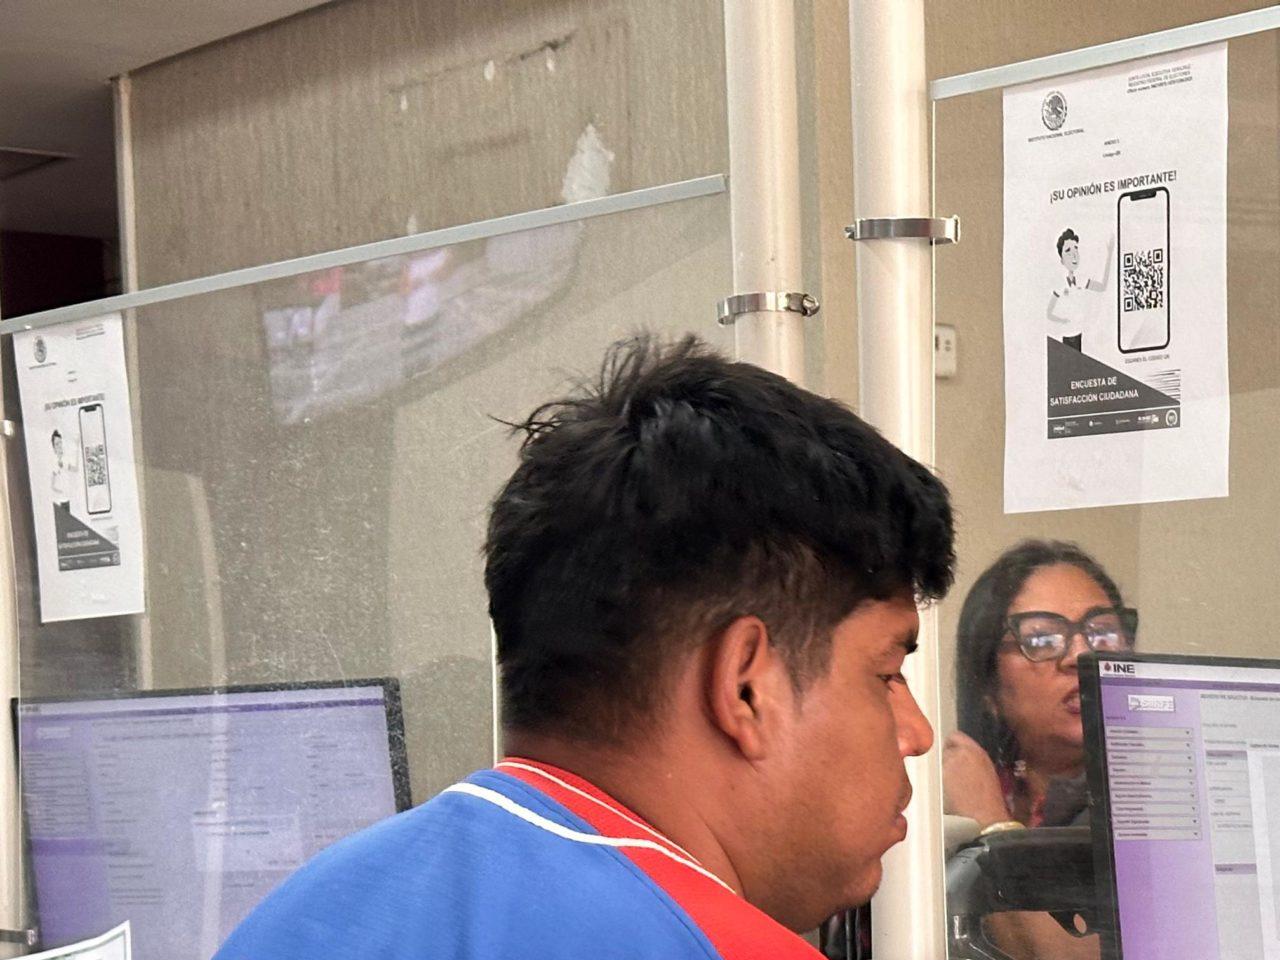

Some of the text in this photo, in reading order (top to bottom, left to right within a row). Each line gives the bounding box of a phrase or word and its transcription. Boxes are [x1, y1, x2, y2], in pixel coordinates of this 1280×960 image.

[1066, 182, 1102, 199] OPINIÓN
[1103, 180, 1116, 193] ES
[1117, 170, 1177, 190] IMPORTANTE!
[1070, 376, 1118, 390] ENCUESTA DE
[1098, 388, 1139, 402] CIUDADANA
[1113, 663, 1136, 673] INE
